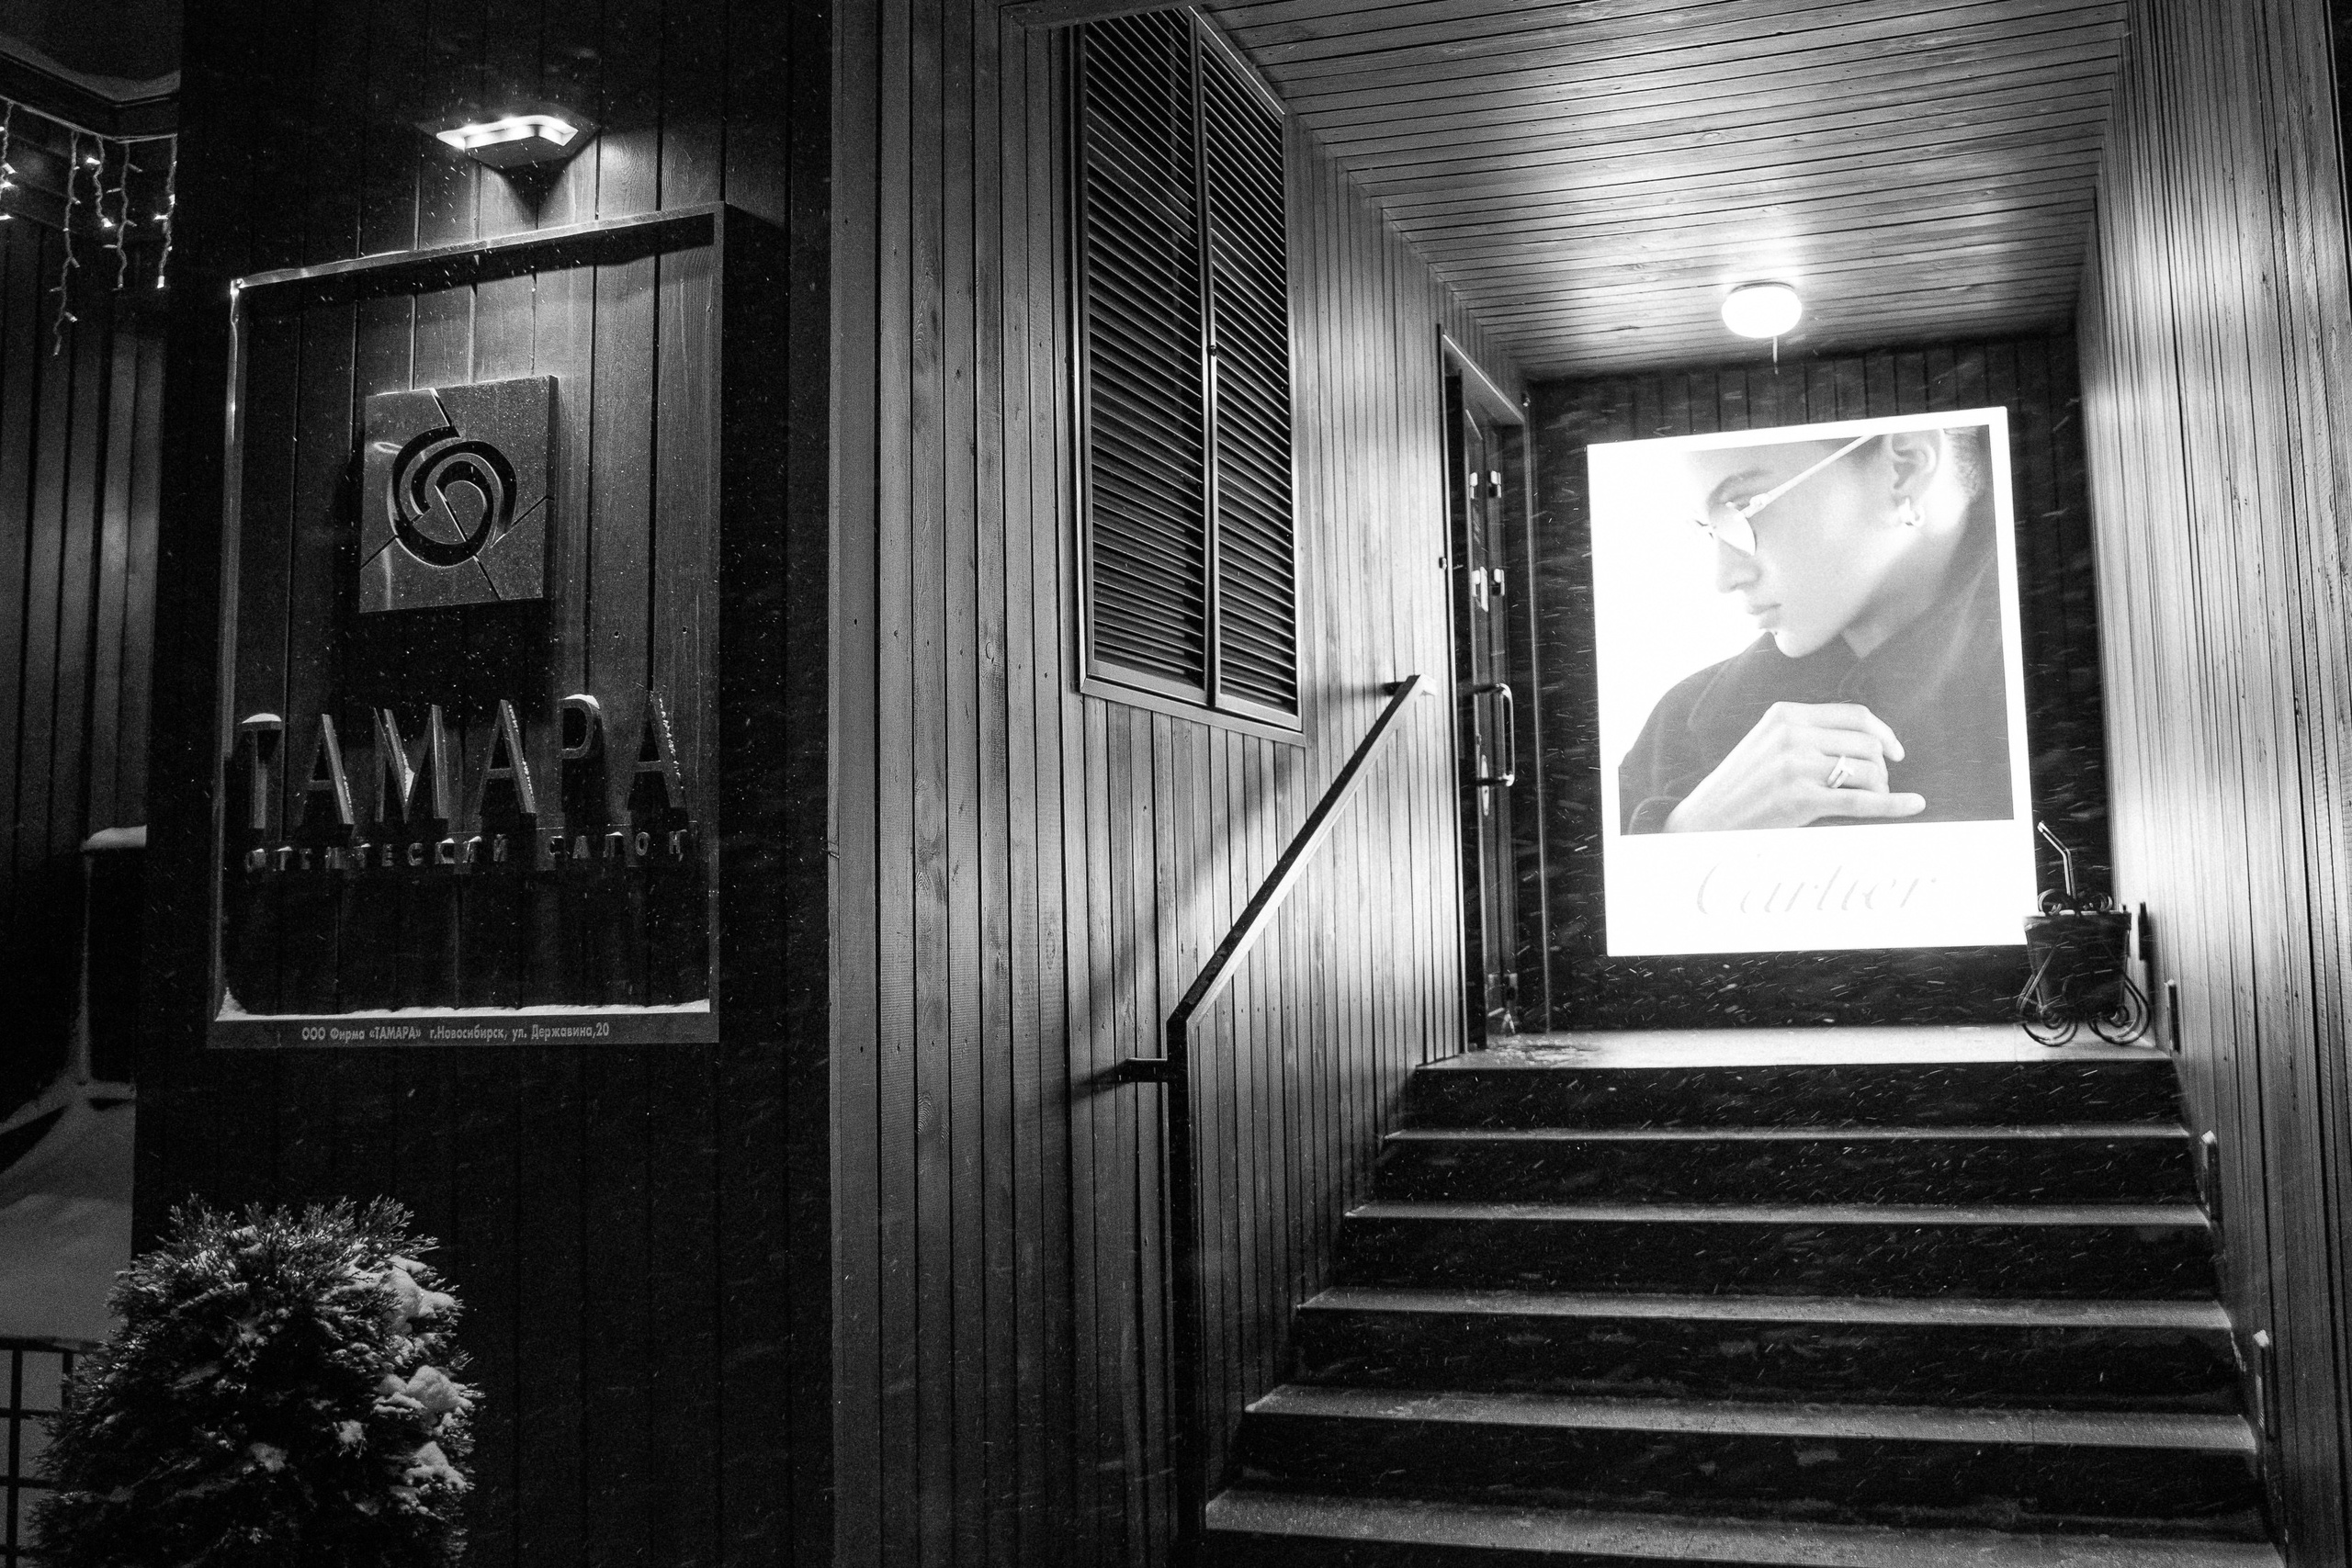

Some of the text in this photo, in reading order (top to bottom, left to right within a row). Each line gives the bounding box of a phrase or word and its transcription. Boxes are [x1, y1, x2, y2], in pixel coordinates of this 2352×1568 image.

[240, 691, 689, 829] ТАМАРА
[1696, 853, 1937, 915] Cartier
[301, 1026, 327, 1041] ООО
[329, 1026, 366, 1044] Фирма
[369, 1025, 423, 1041] «ТАМАРА»
[512, 1027, 528, 1043] ул.
